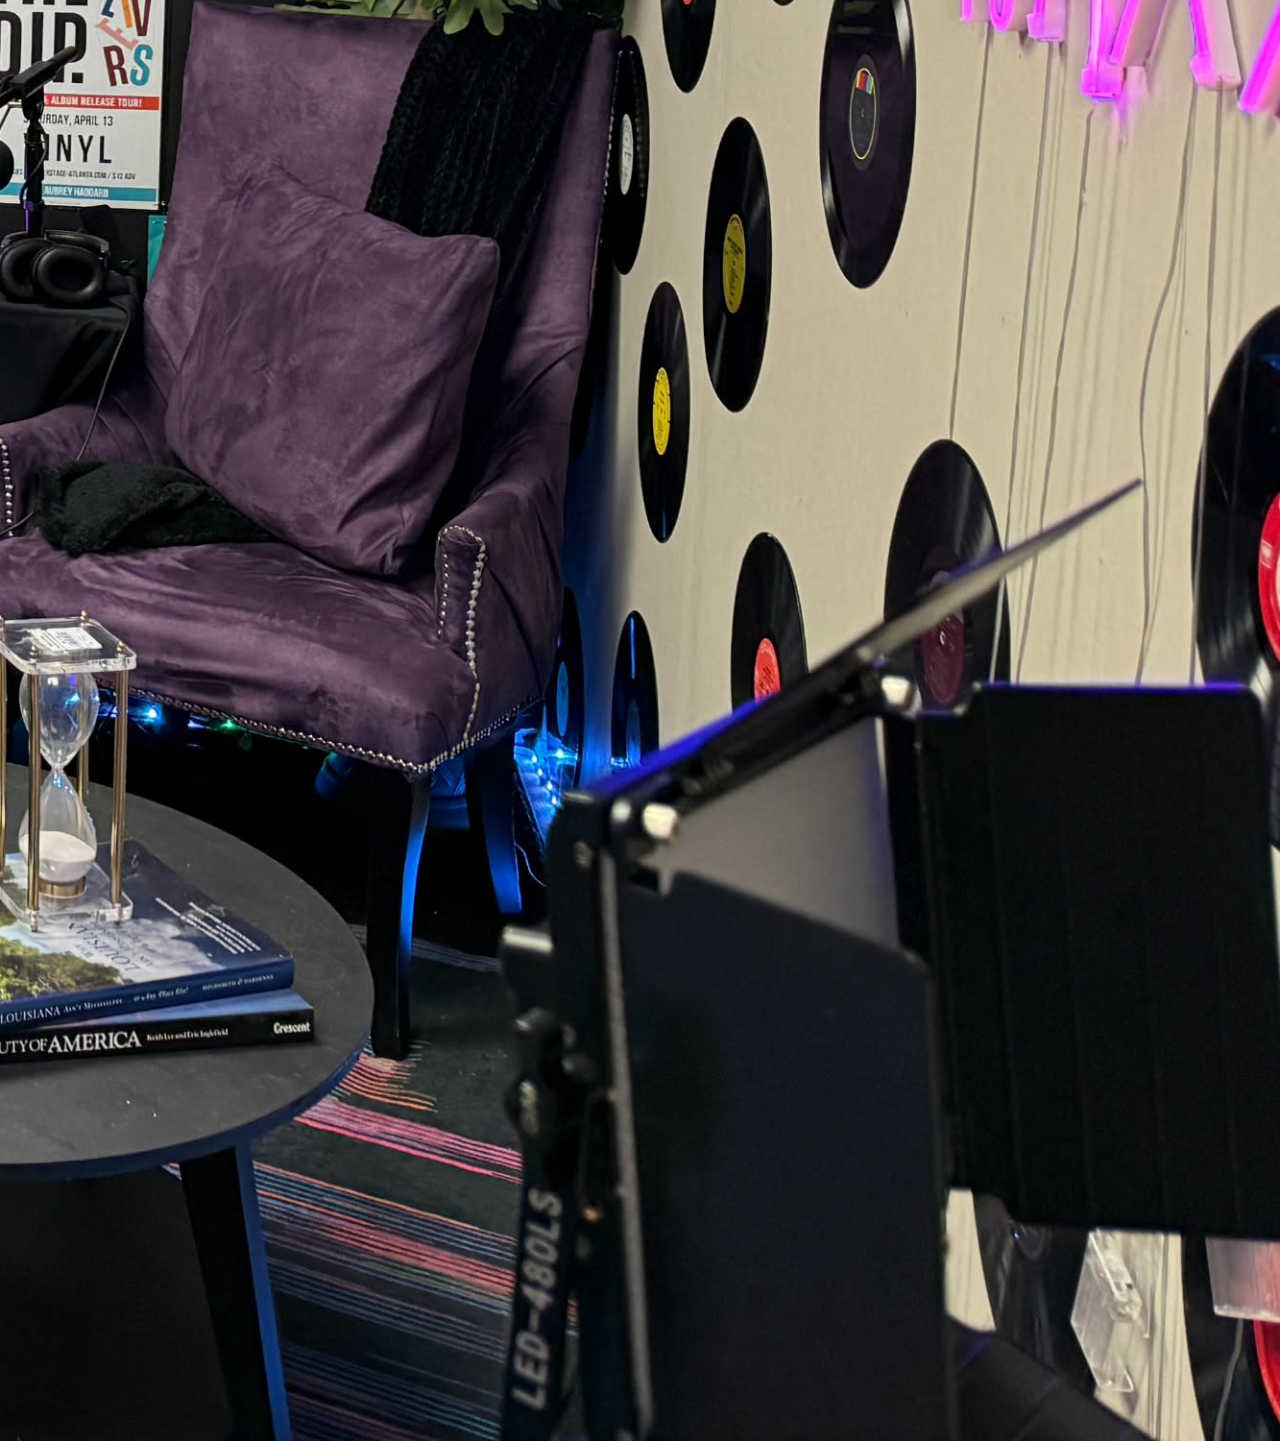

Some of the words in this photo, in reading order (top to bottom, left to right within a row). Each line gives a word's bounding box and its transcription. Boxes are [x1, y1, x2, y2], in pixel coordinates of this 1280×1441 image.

[51, 97, 79, 106] ALBUM
[81, 97, 117, 107] RELEASE
[118, 98, 143, 108] TOUR!
[74, 115, 99, 127] APRIL
[103, 116, 114, 127] 13
[0, 1006, 61, 1025] LOUISIANA
[273, 1021, 311, 1035] Crescent
[28, 1037, 48, 1053] OF
[48, 1030, 142, 1054] AMERICA
[510, 1186, 565, 1410] LED-480LS
